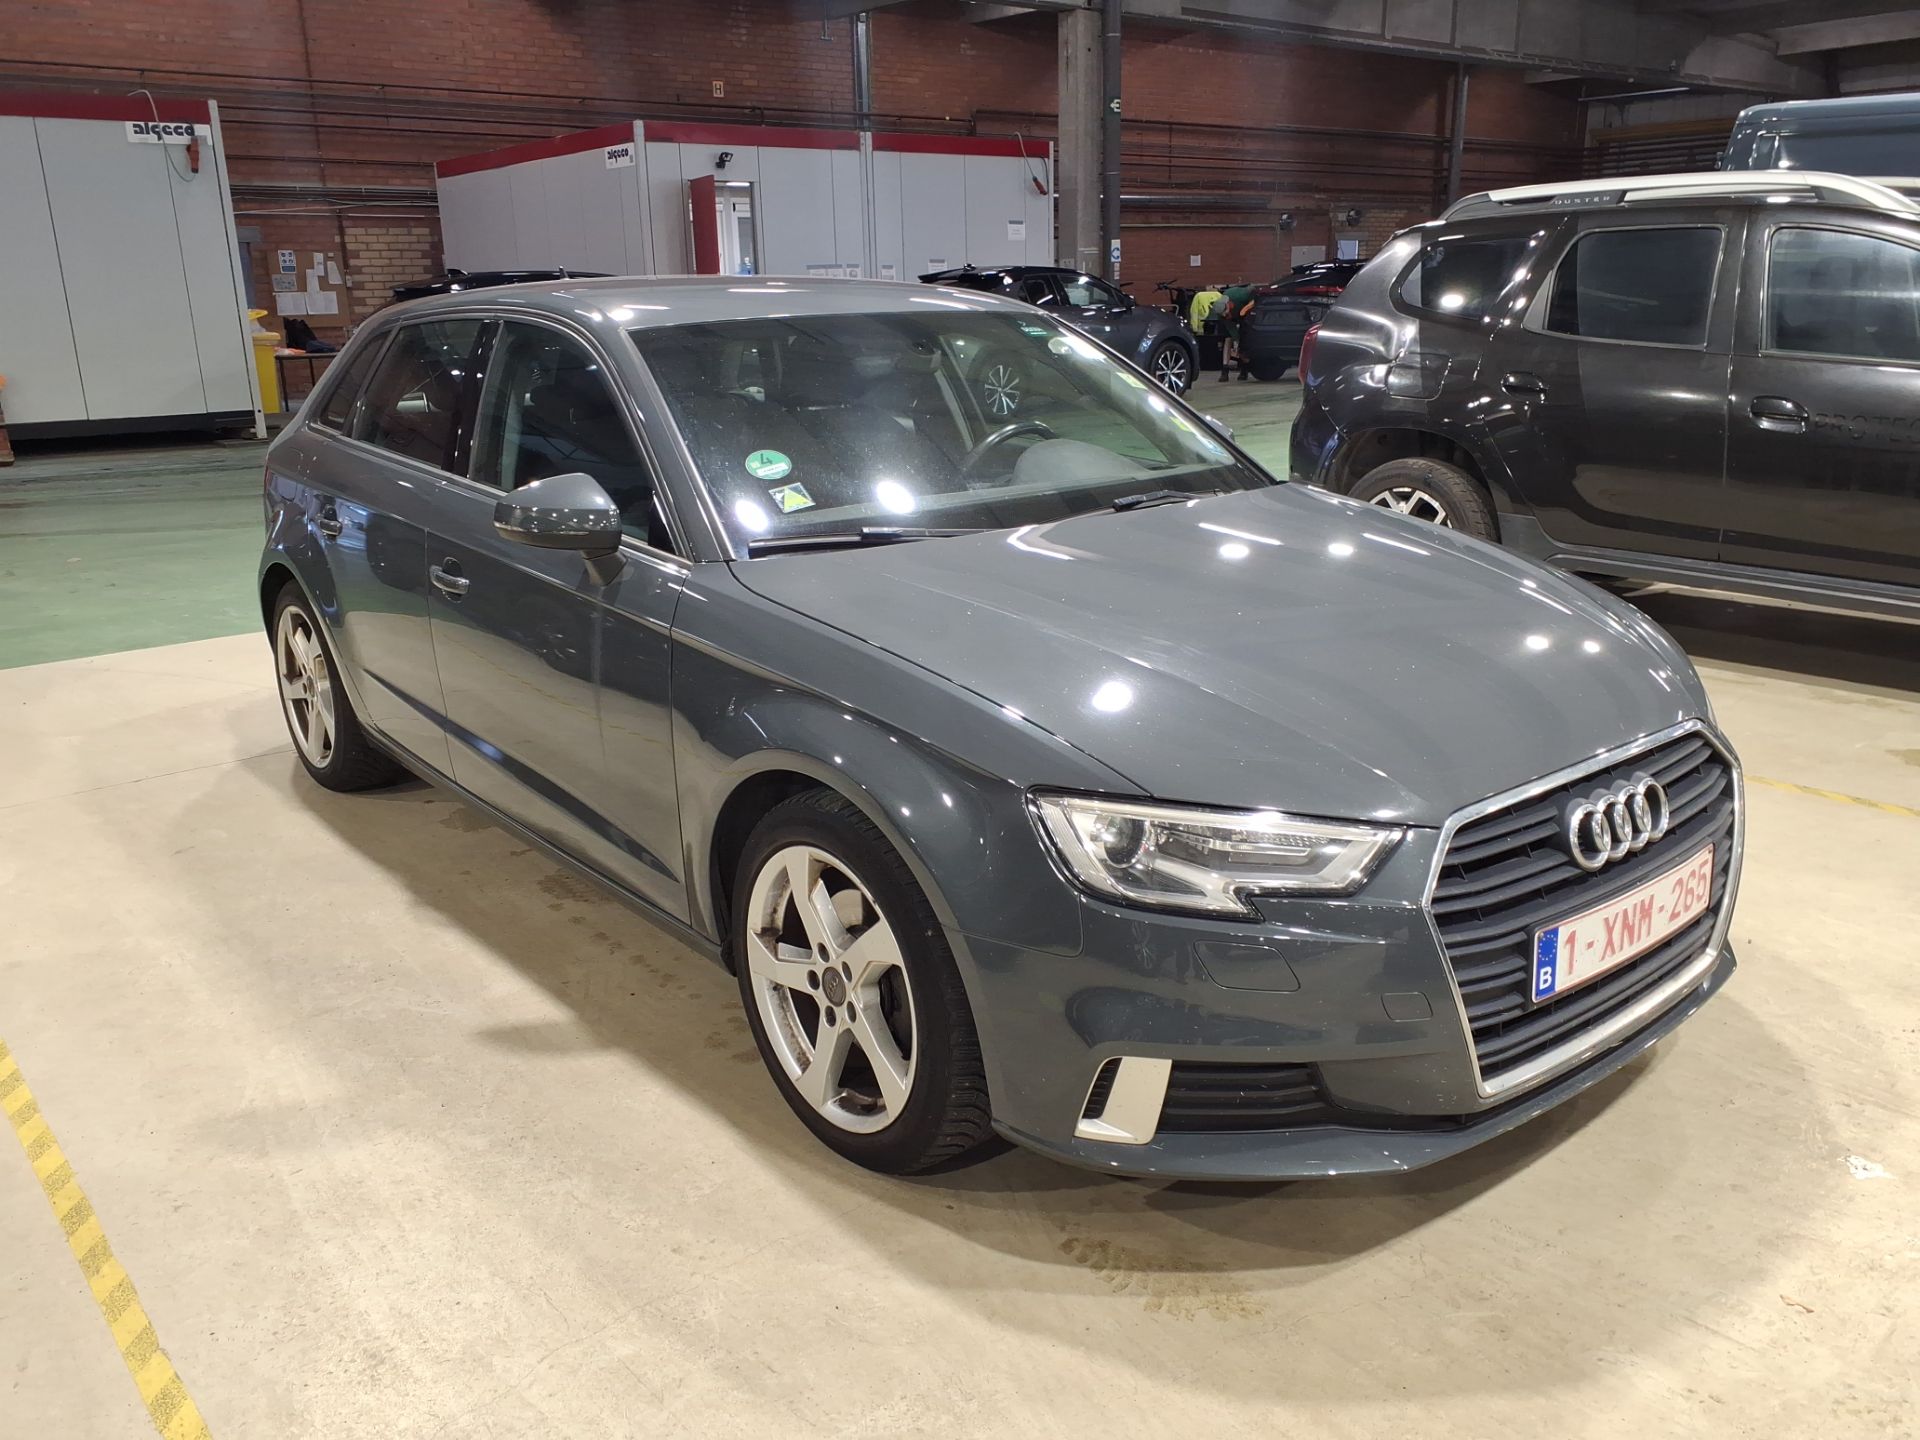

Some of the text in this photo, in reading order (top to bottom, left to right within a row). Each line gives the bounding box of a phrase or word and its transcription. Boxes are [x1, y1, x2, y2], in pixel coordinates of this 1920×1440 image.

[132, 122, 196, 142] algeco
[760, 453, 773, 465] 4
[1563, 858, 1709, 976] 1-XNM-265
[1538, 965, 1553, 991] B
